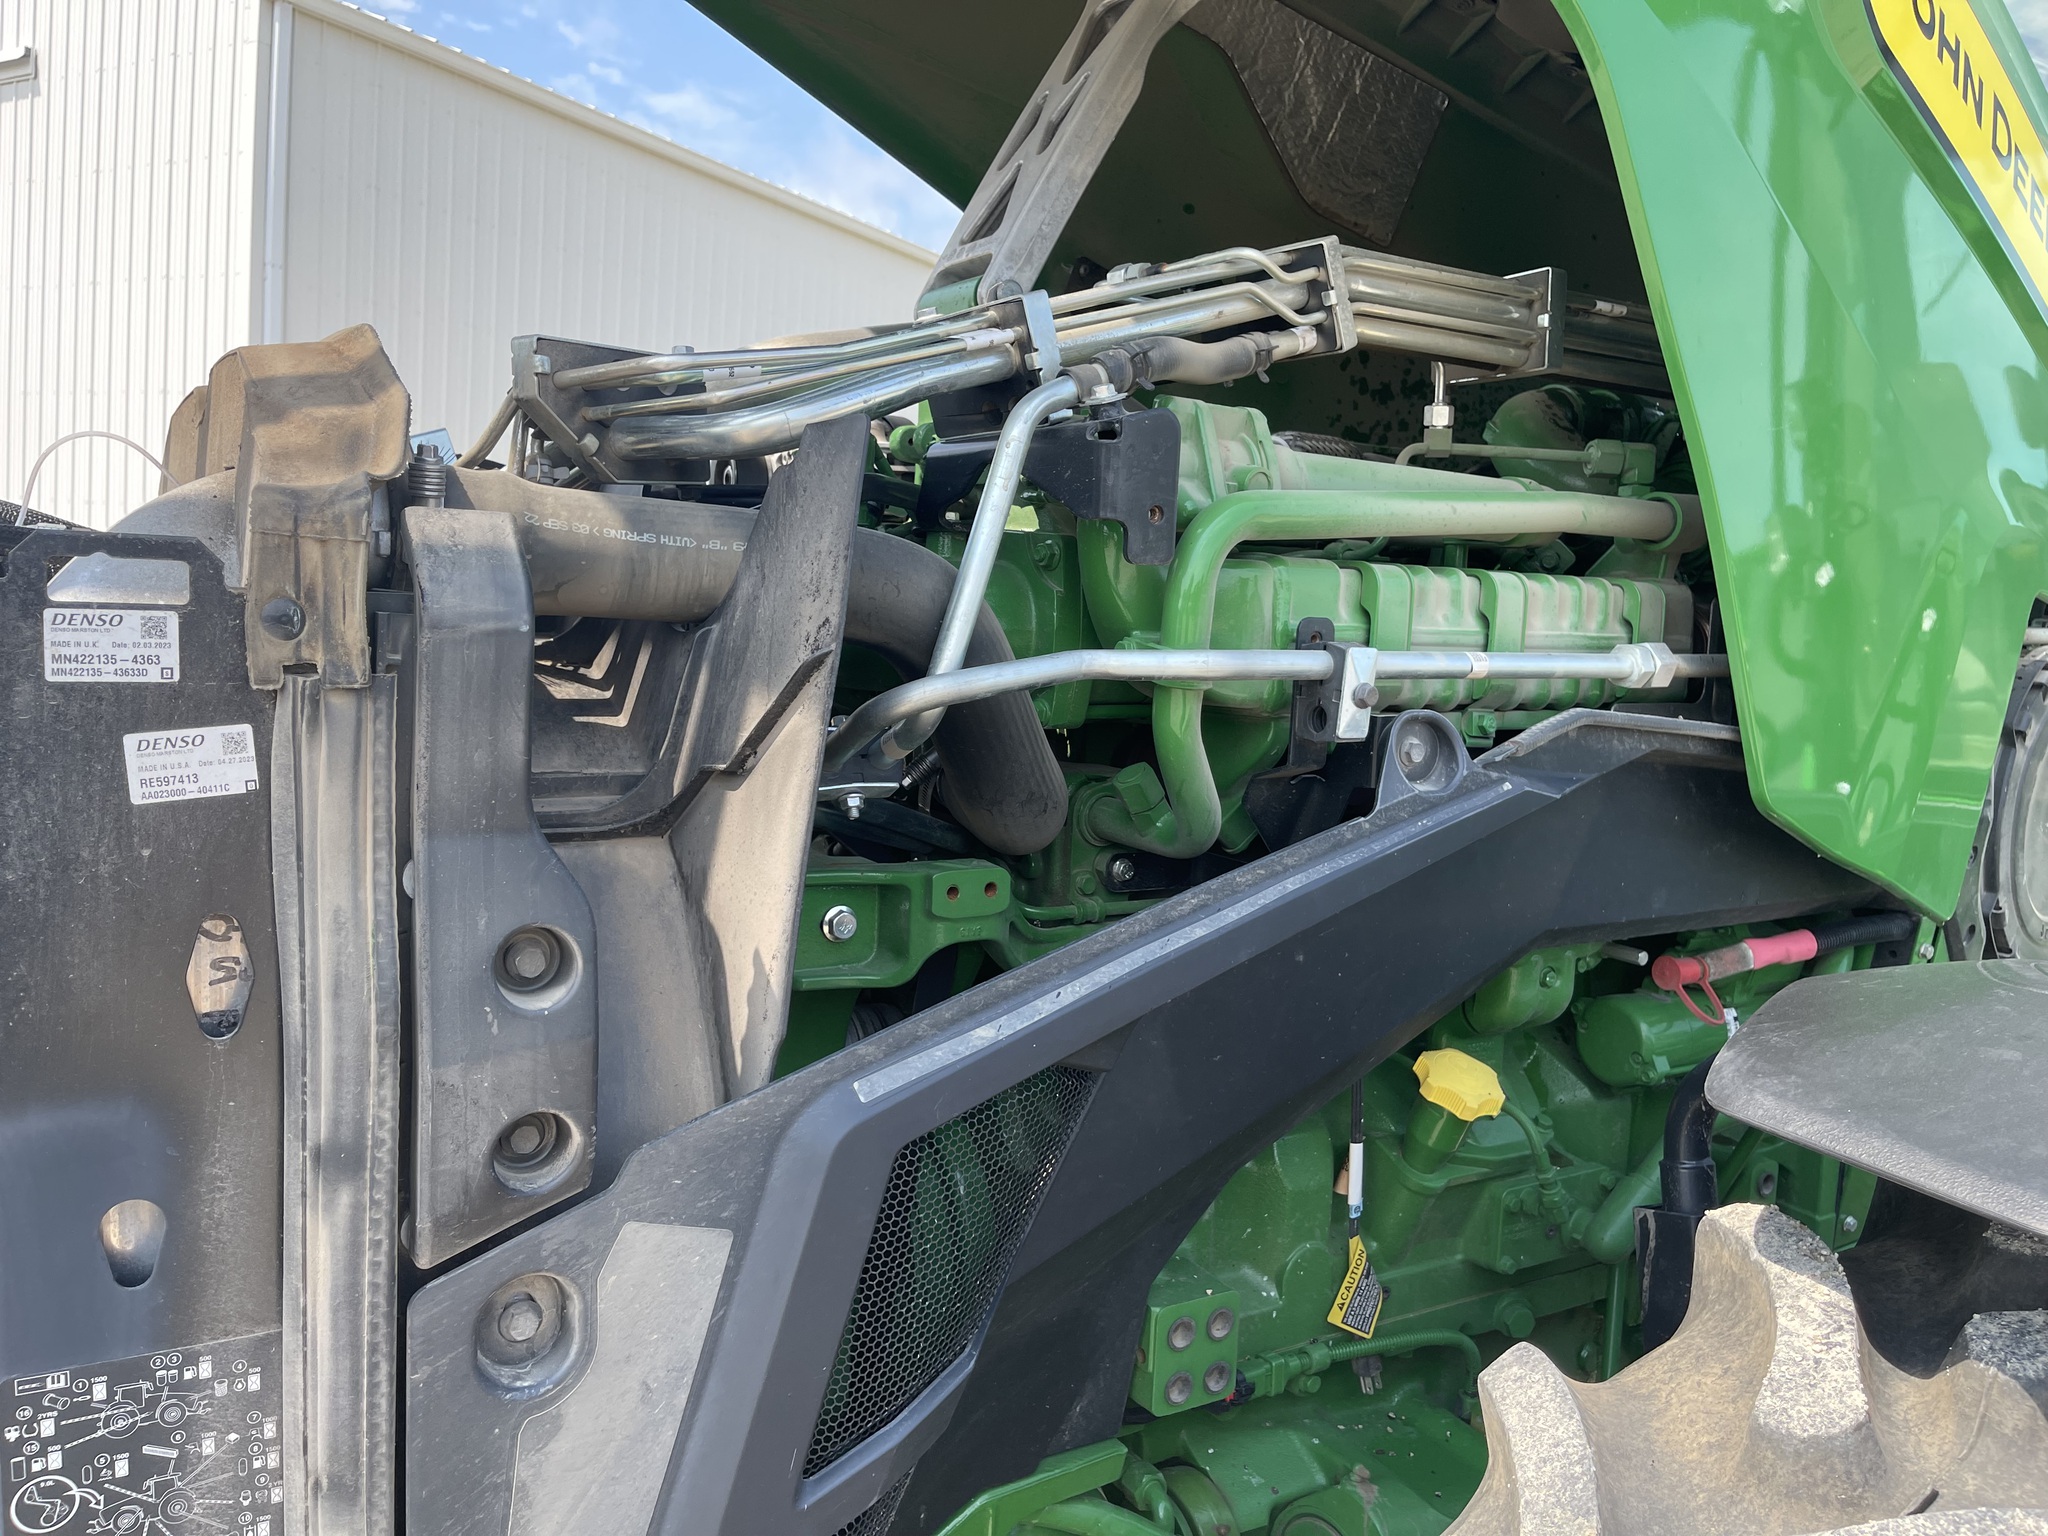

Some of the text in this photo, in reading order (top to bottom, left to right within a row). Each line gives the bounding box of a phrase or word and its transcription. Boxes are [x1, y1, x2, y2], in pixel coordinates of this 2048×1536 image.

[1991, 91, 2048, 253] DEE
[523, 511, 540, 526] 22
[542, 518, 569, 531] SEP
[603, 527, 657, 544] SPRING
[50, 613, 124, 628] DENSO
[50, 640, 71, 648] MADE
[132, 641, 172, 649] 02.03.2023
[136, 734, 206, 752] DENSO
[137, 764, 158, 773] MADE
[159, 763, 168, 771] IN
[198, 759, 216, 767] Date:
[139, 773, 200, 789] RE597413
[1340, 1248, 1366, 1301] CAUTION
[248, 1366, 262, 1374] 500
[90, 1375, 108, 1384] 1500
[200, 1430, 217, 1439] 1000
[47, 1444, 62, 1452] 500
[112, 1452, 130, 1461] 1500
[255, 1514, 272, 1522] 1500
